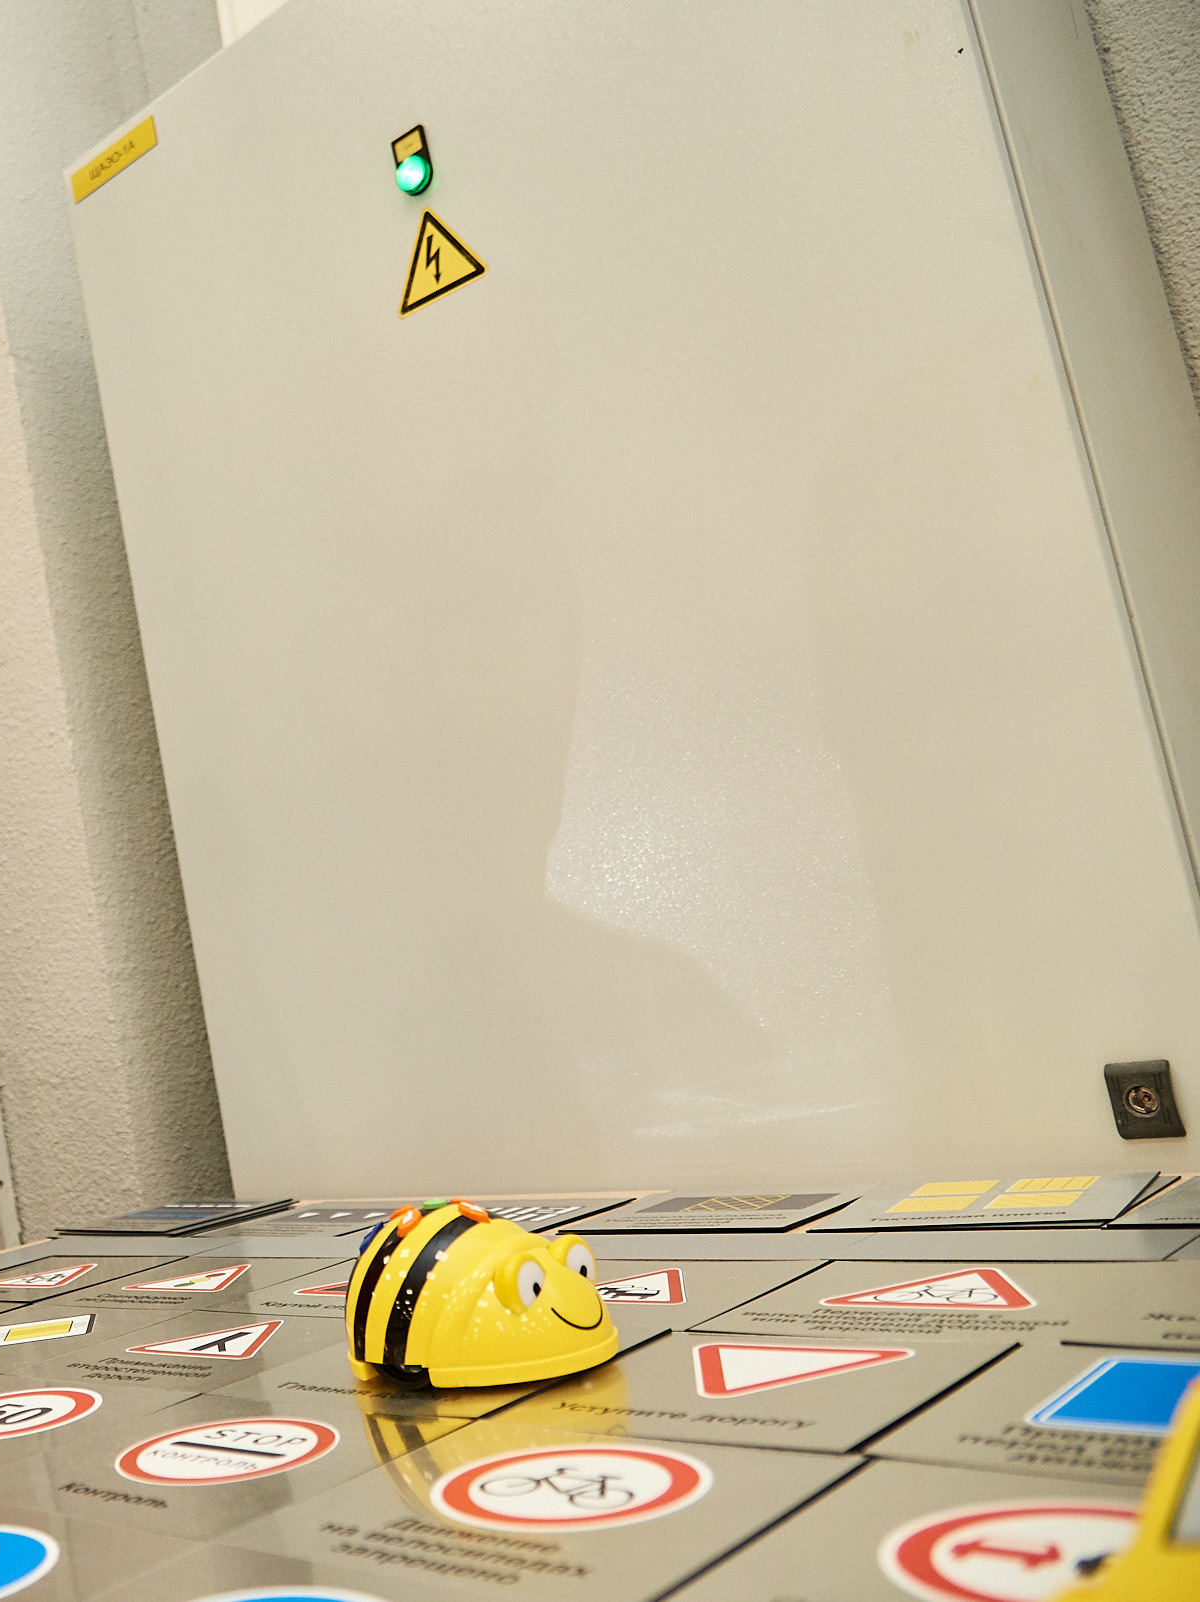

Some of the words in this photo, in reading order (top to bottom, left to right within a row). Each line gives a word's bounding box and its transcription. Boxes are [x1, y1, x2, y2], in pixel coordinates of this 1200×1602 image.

[742, 1311, 921, 1323] велосипедной
[929, 1316, 1069, 1328] дорожкой
[751, 1316, 797, 1324] или
[812, 1308, 979, 1321] Пересечение
[807, 1325, 942, 1334] дорожкой
[66, 1362, 215, 1378] второстепенной
[99, 1357, 213, 1371] Примыкание
[82, 1372, 152, 1381] дороги
[277, 1380, 371, 1396] Главная
[552, 1402, 689, 1420] Уступите
[691, 1412, 818, 1430] дорогу
[203, 1429, 308, 1448] STOP
[146, 1448, 259, 1471] КОНТРОЛЬ
[57, 1482, 169, 1509] Контроль
[384, 1518, 561, 1553] Движение
[319, 1522, 360, 1537] на
[362, 1531, 595, 1578] велосипедах
[331, 1543, 521, 1586] запрещено
